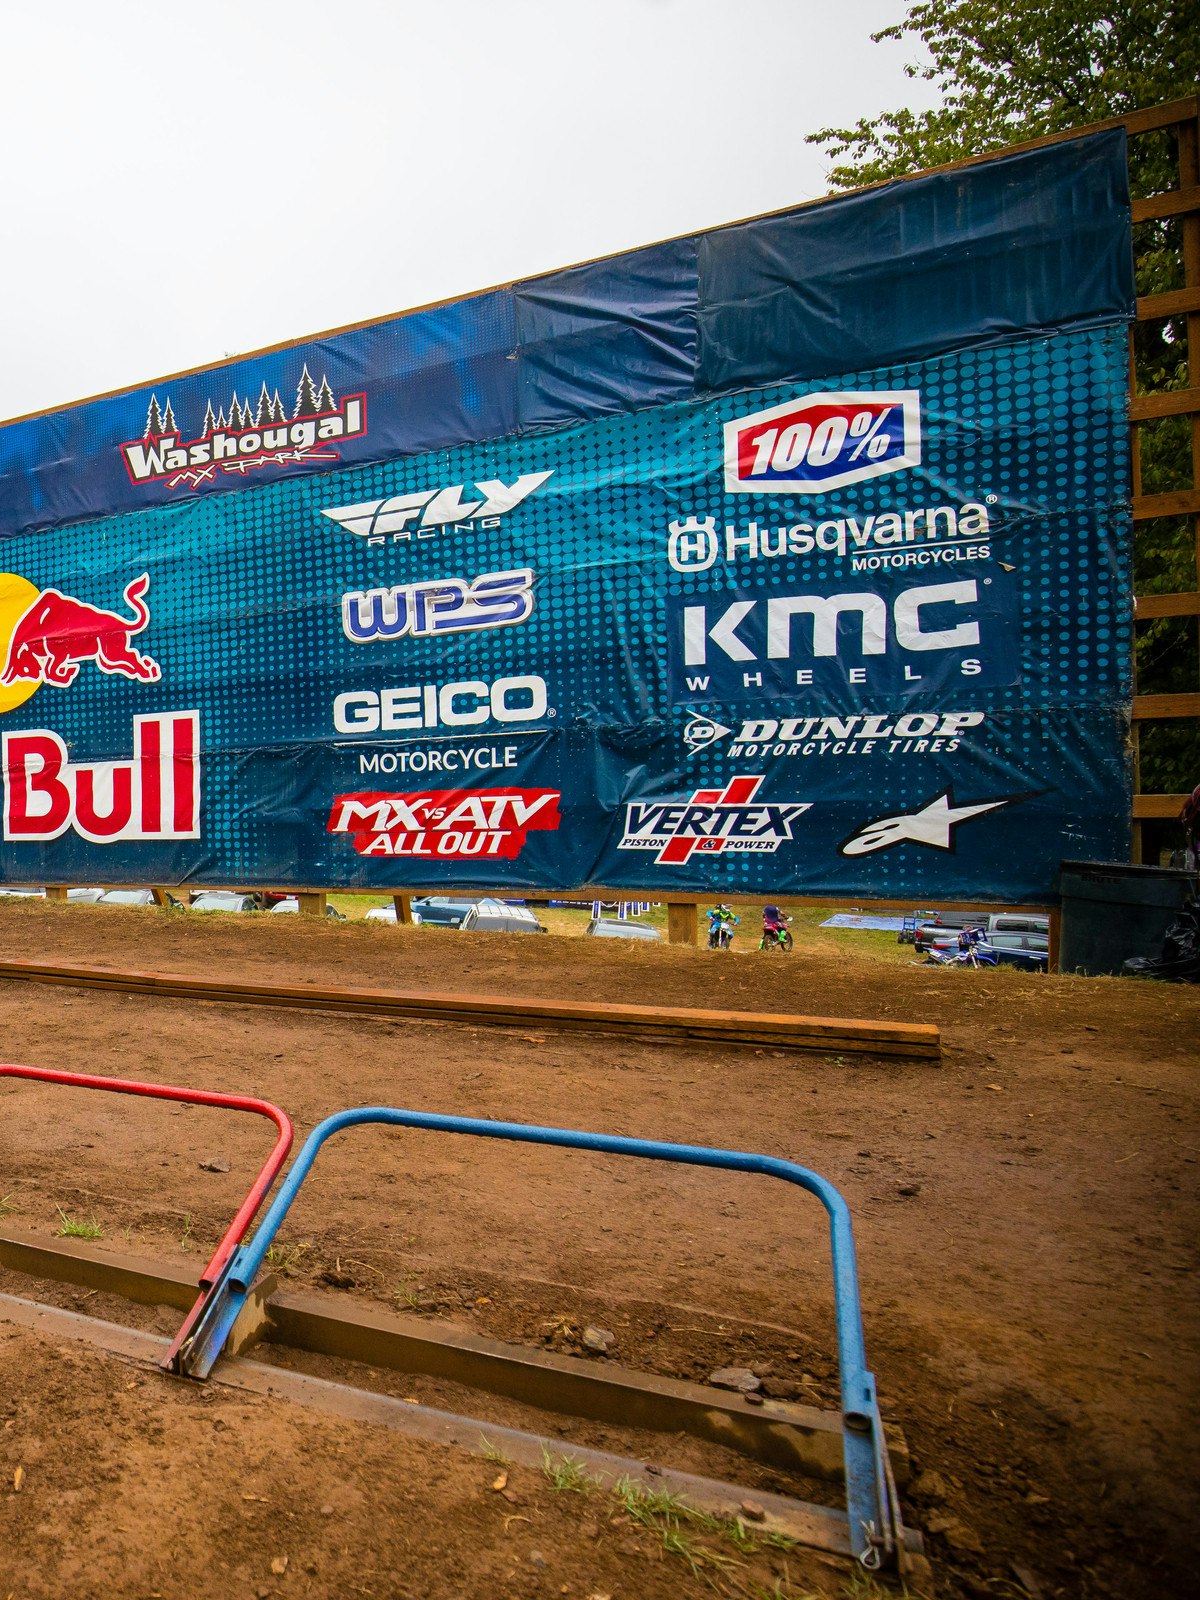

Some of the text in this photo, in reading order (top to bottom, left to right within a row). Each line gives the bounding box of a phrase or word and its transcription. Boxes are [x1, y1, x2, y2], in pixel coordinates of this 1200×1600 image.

[126, 399, 361, 479] Washougal
[750, 407, 893, 476] 100%
[168, 448, 337, 488] MX PARK
[320, 469, 556, 536] FLY
[367, 517, 501, 547] RACING
[726, 503, 990, 561] Husqvarna
[852, 546, 991, 571] MOTORCYCLES
[341, 567, 536, 644] WPS
[686, 659, 982, 692] WHEELS
[333, 675, 548, 734] GEICO
[733, 711, 986, 743] DUNLOP
[359, 746, 518, 774] MOTORCYCLE
[727, 738, 961, 758] MOTORCYCLE TIRES
[2, 709, 201, 843] Bull
[332, 797, 433, 832] MX
[433, 793, 561, 831] ATV
[628, 805, 804, 837] VERTEX
[359, 830, 512, 855] ALL OUT
[621, 838, 776, 850] PISTON & POWER
